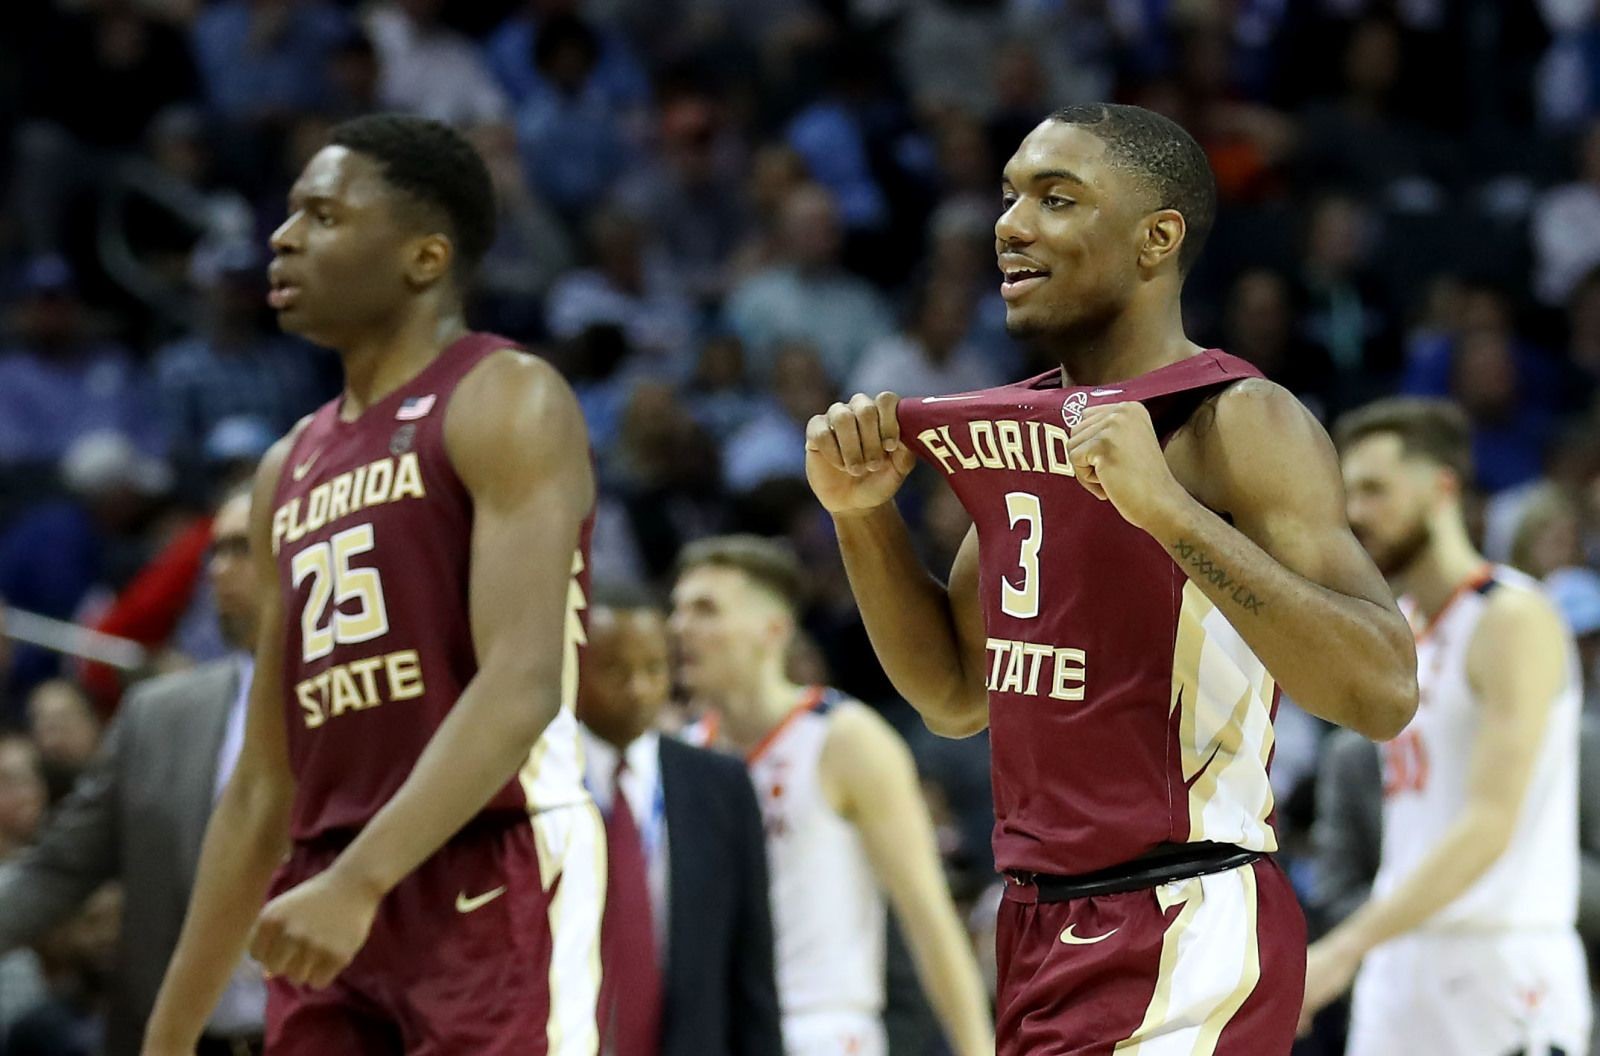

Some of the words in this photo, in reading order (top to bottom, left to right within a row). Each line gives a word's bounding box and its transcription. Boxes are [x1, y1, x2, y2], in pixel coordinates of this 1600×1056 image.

[917, 420, 1076, 477] FLORID
[272, 452, 426, 556] FLORIDA
[291, 522, 389, 664] 25
[1001, 491, 1042, 618] 3
[295, 649, 425, 728] STATE
[985, 637, 1086, 701] TATE
